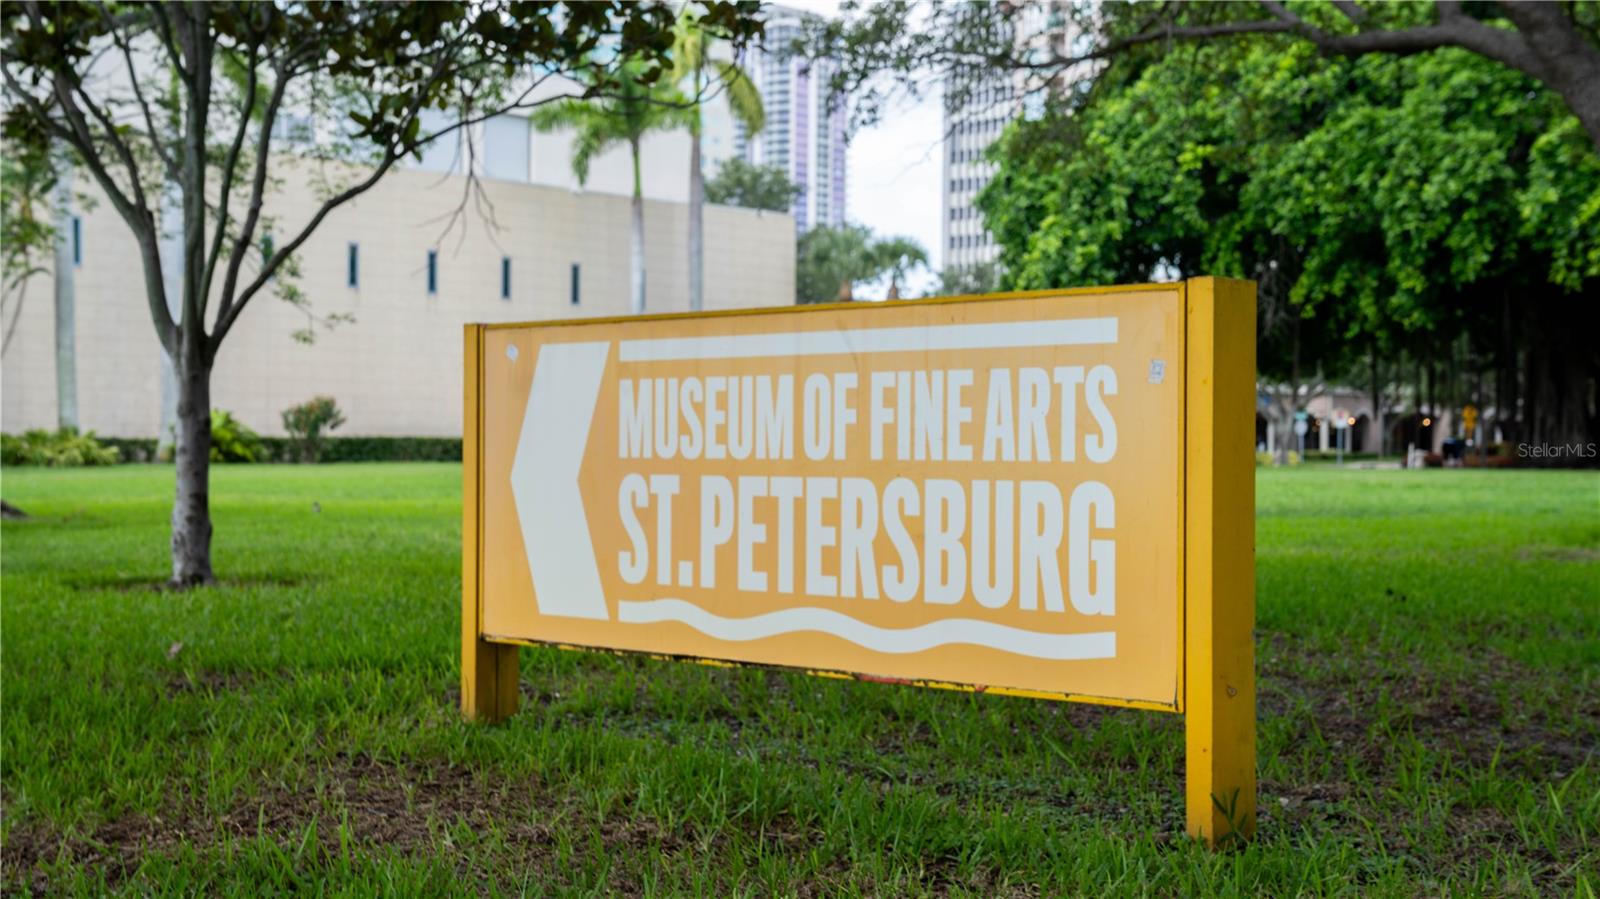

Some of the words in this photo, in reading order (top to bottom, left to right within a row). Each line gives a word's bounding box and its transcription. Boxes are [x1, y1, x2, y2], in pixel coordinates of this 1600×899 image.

[618, 372, 795, 460] MUSEUM
[802, 371, 859, 461] OF
[869, 367, 975, 462] FINE
[981, 363, 1119, 465] ARTS
[618, 472, 694, 587] ST.
[699, 475, 1116, 617] PETERSBURG
